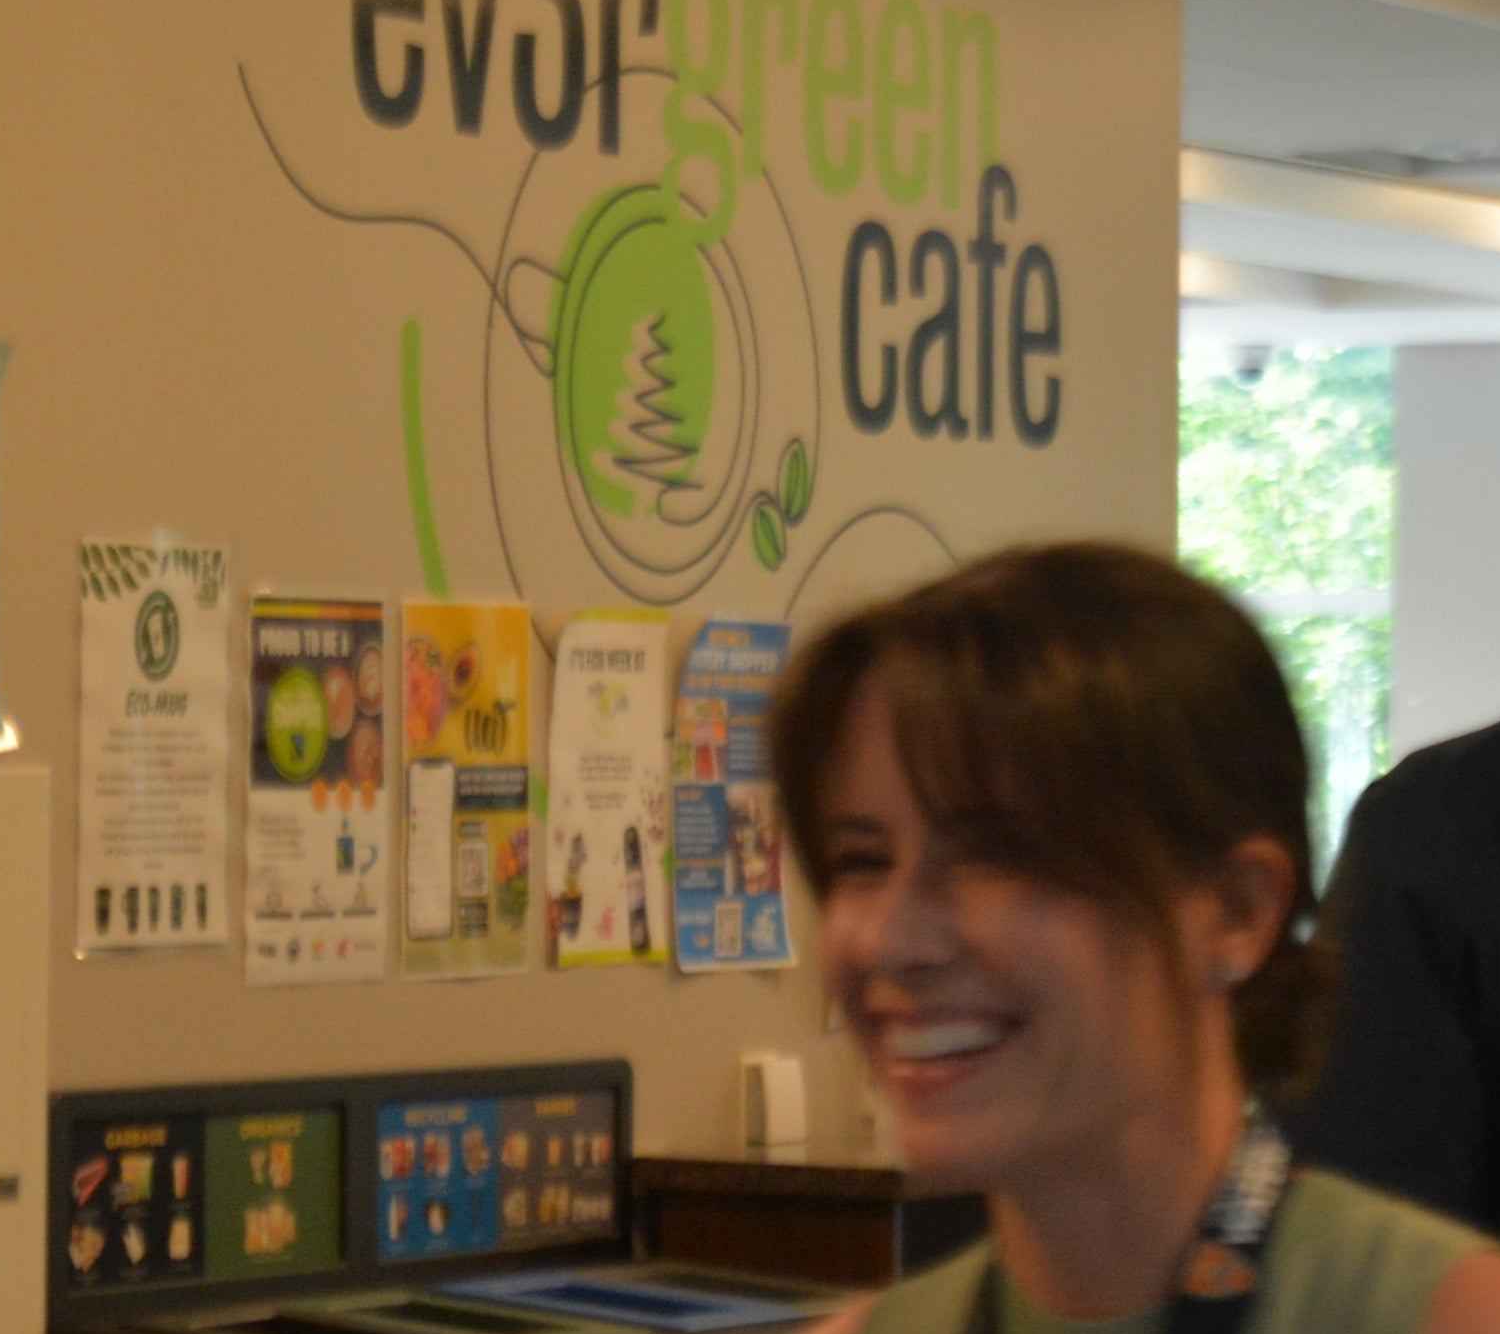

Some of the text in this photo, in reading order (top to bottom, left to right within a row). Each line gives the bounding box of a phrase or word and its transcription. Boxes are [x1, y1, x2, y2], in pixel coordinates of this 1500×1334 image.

[840, 164, 1063, 450] cafe
[258, 629, 300, 659] PROUD
[305, 630, 321, 659] TO
[125, 690, 189, 719] ECO-MUG
[105, 1124, 168, 1150] GARBAGE
